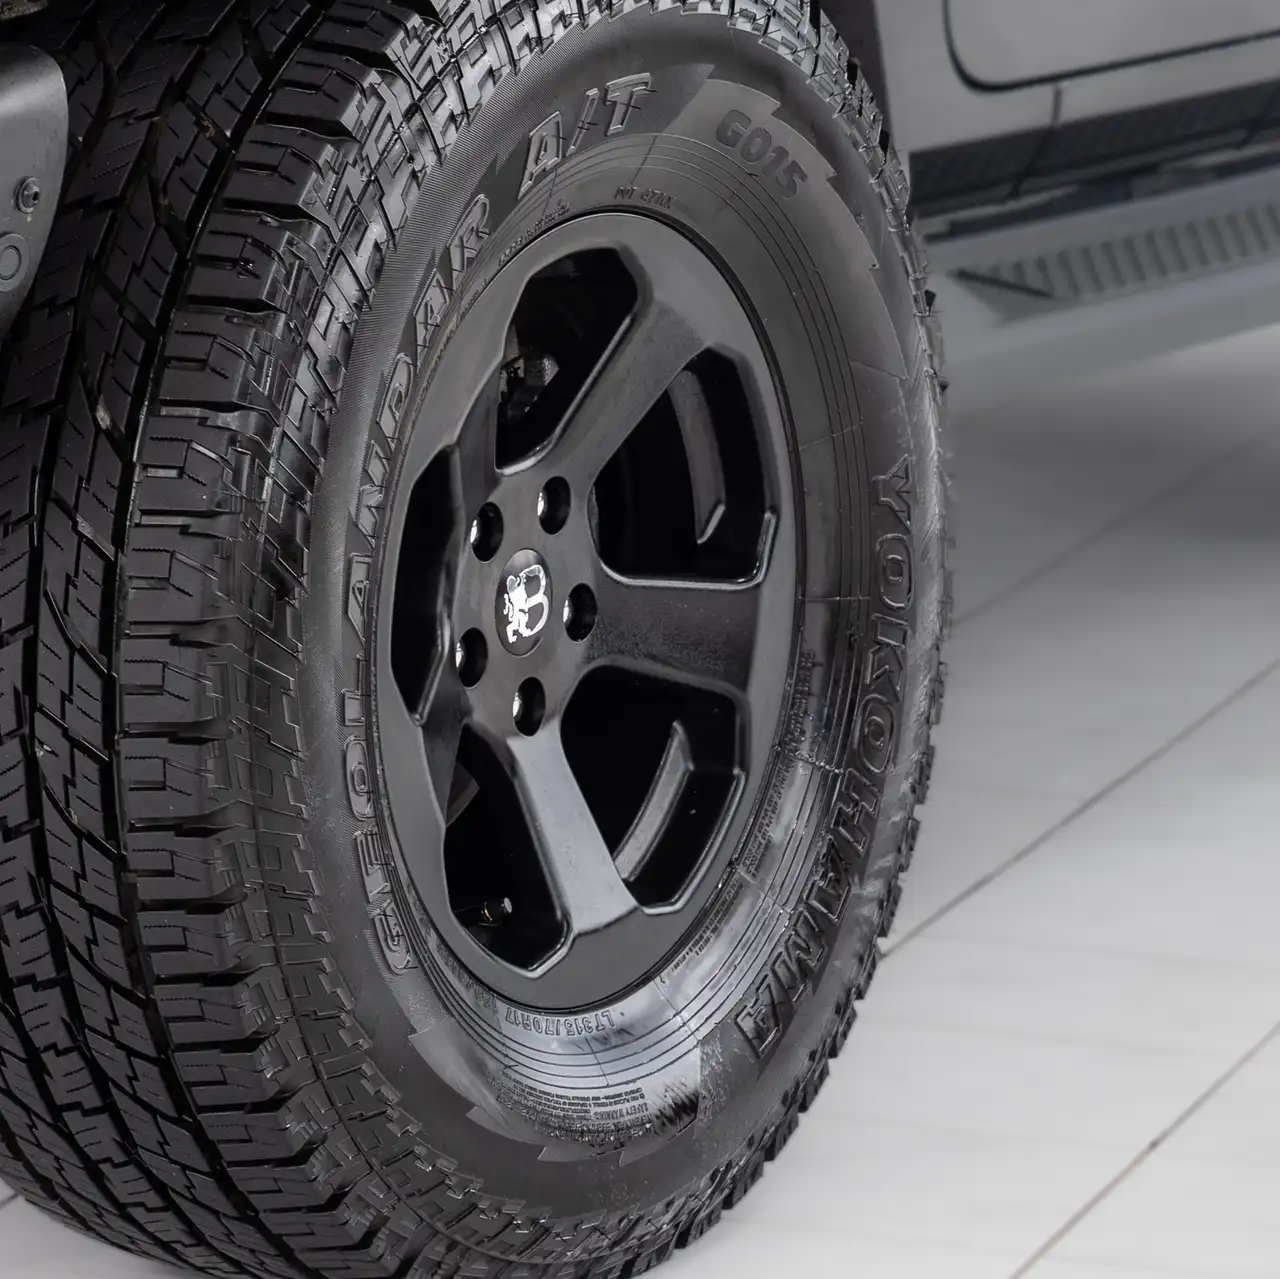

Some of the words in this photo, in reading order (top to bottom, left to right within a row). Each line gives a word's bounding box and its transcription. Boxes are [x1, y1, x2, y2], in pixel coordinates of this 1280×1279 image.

[517, 72, 653, 200] A/T
[715, 108, 809, 200] G015
[735, 454, 914, 1059] YOKOHAMA
[505, 1006, 617, 1037] LT315/70R17
